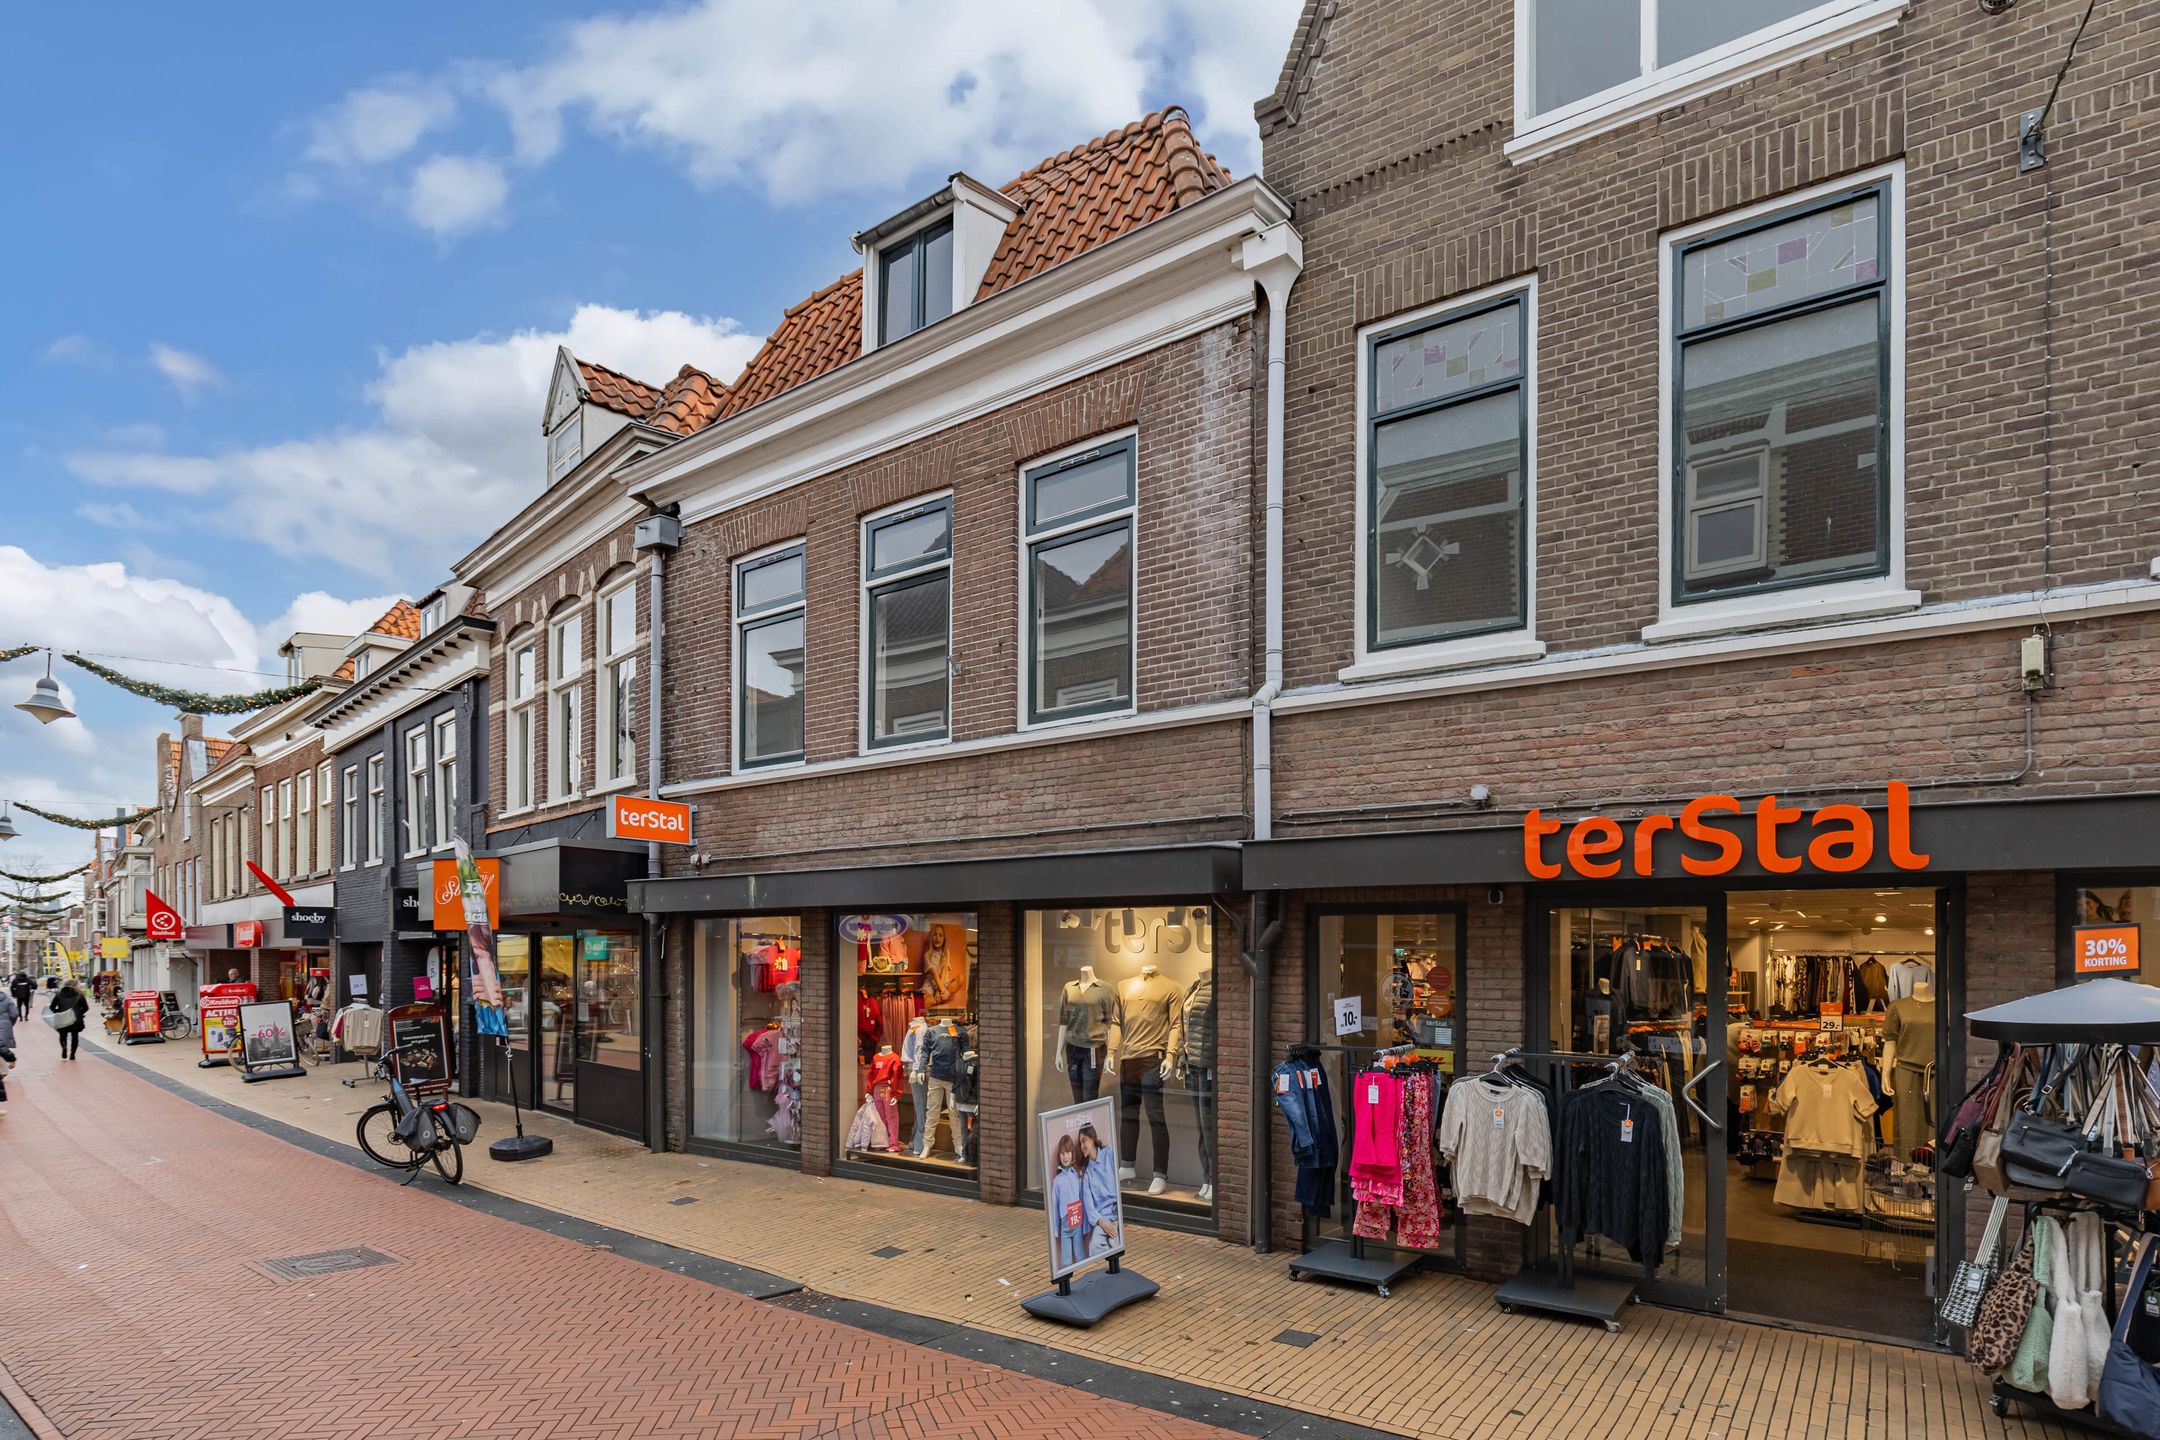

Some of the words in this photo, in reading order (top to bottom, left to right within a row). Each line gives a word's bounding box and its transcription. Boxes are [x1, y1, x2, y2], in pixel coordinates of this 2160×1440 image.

[620, 807, 685, 832] terStal
[1523, 780, 1931, 879] terStal
[291, 912, 326, 924] shoeby
[2085, 938, 2127, 956] 30%
[2084, 956, 2127, 968] KORTING
[210, 998, 239, 1006] Kruidvat
[1065, 1112, 1092, 1129] terStal
